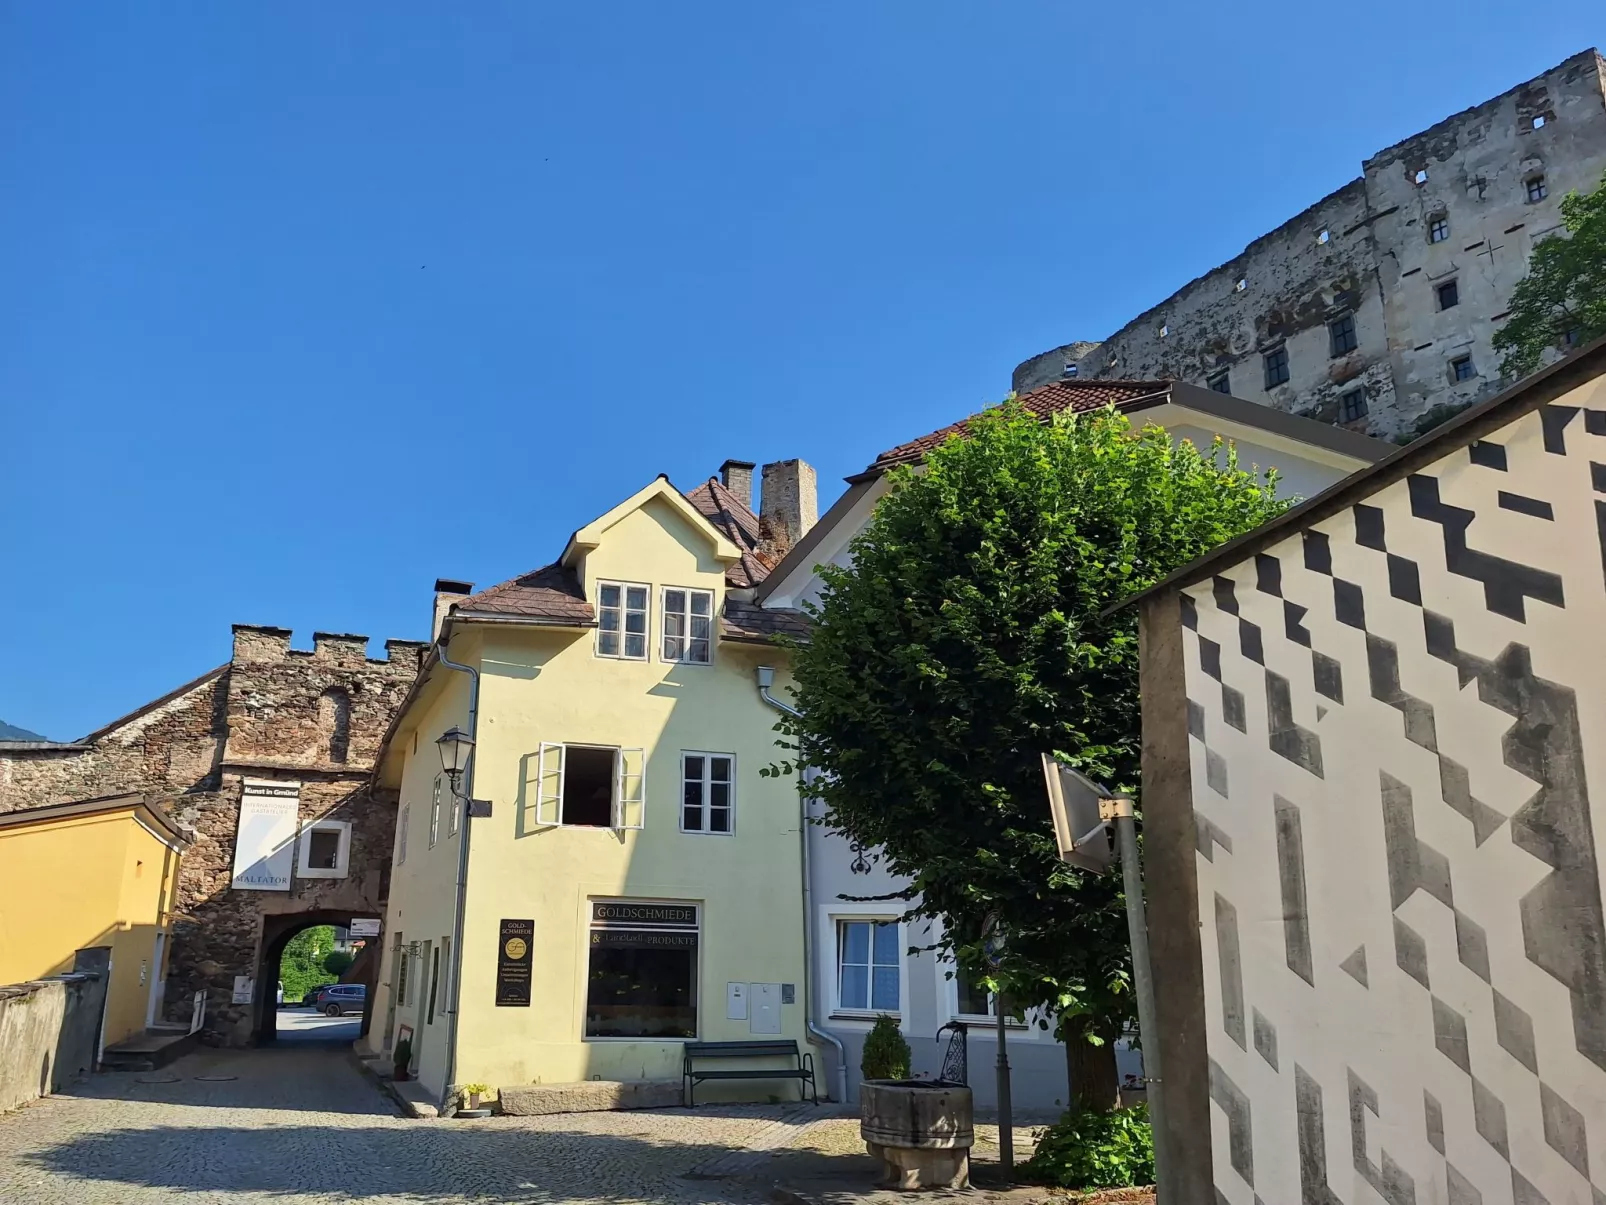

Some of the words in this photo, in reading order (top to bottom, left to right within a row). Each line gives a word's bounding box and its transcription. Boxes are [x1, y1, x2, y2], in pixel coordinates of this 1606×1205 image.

[244, 786, 265, 794] Kunst
[235, 875, 288, 884] MALTATOR
[597, 907, 692, 920] GOLDSCHMIEDE
[647, 936, 695, 945] PRODUKTE
